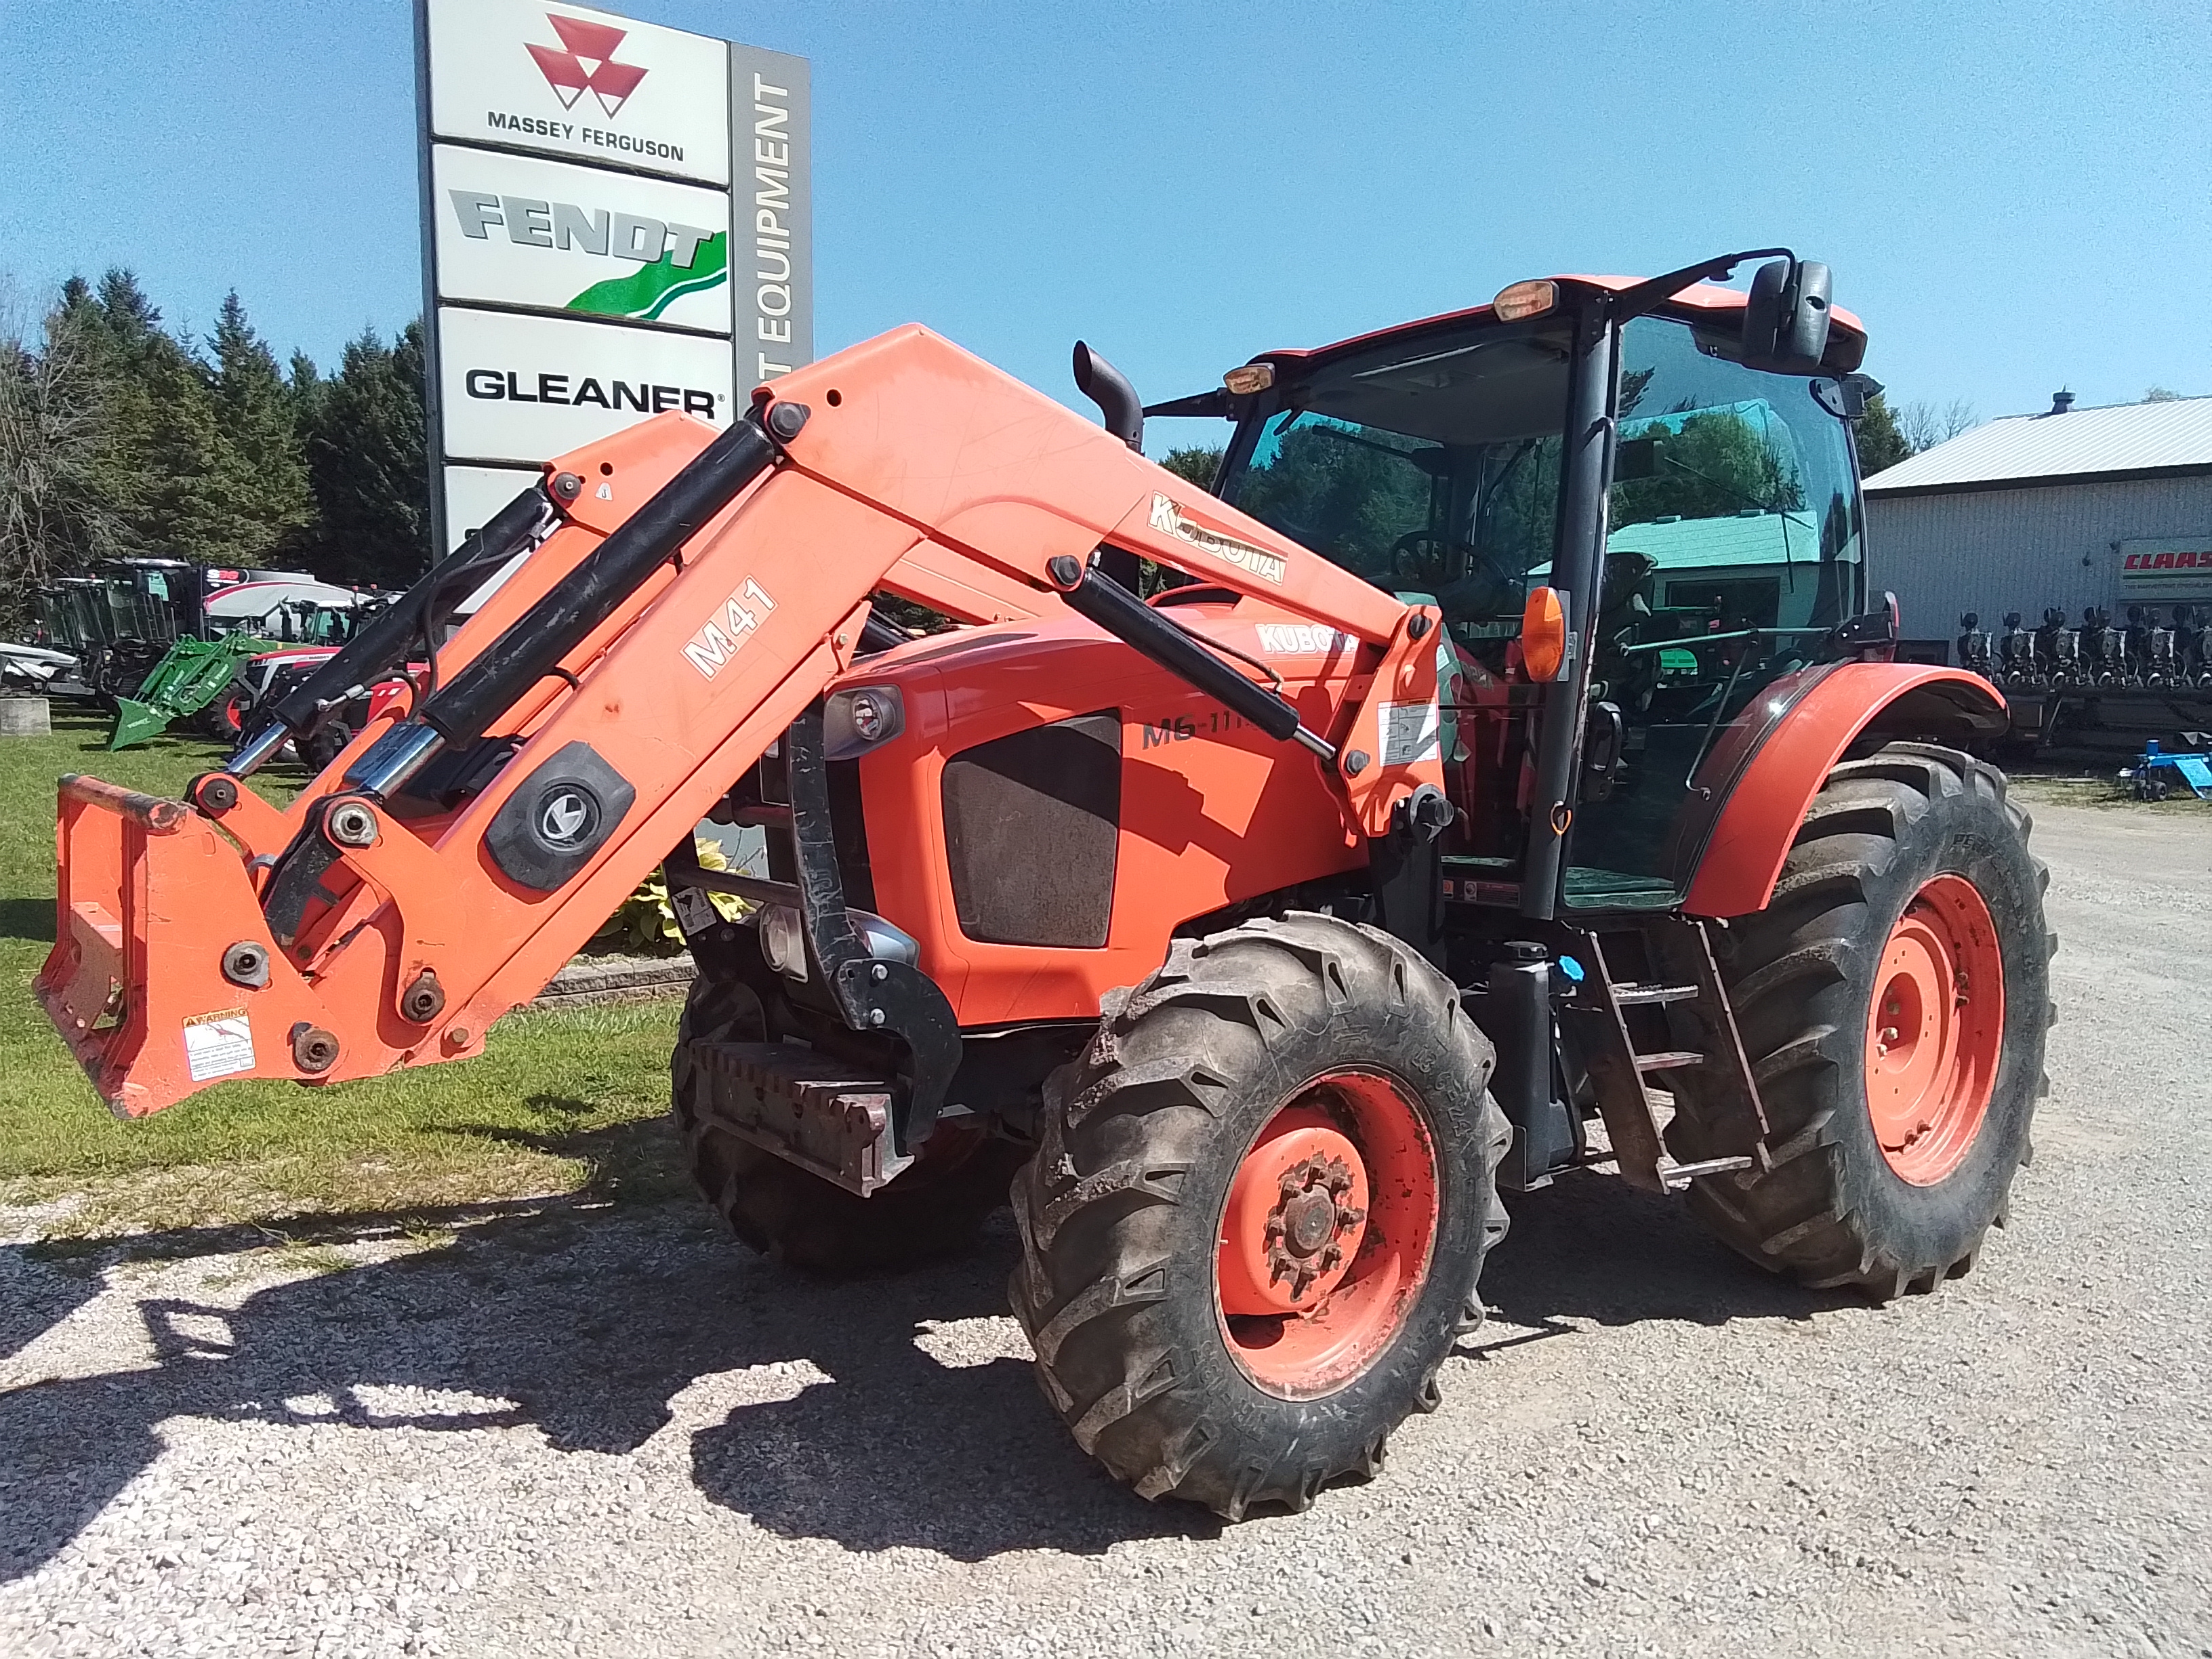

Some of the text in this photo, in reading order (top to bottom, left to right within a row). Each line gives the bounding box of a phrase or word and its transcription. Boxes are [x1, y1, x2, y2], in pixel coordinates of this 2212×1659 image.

[487, 111, 684, 161] MASSEY FERGUSON
[448, 189, 715, 269] FENDT
[754, 72, 792, 344] EQUIPMENT
[466, 369, 715, 419] GLEANER
[2124, 552, 2212, 569] CLAAS
[682, 577, 776, 678] M41
[1256, 625, 1358, 653] KUBOTA
[1142, 710, 1258, 750] M6-111
[195, 1008, 246, 1025] WARNING
